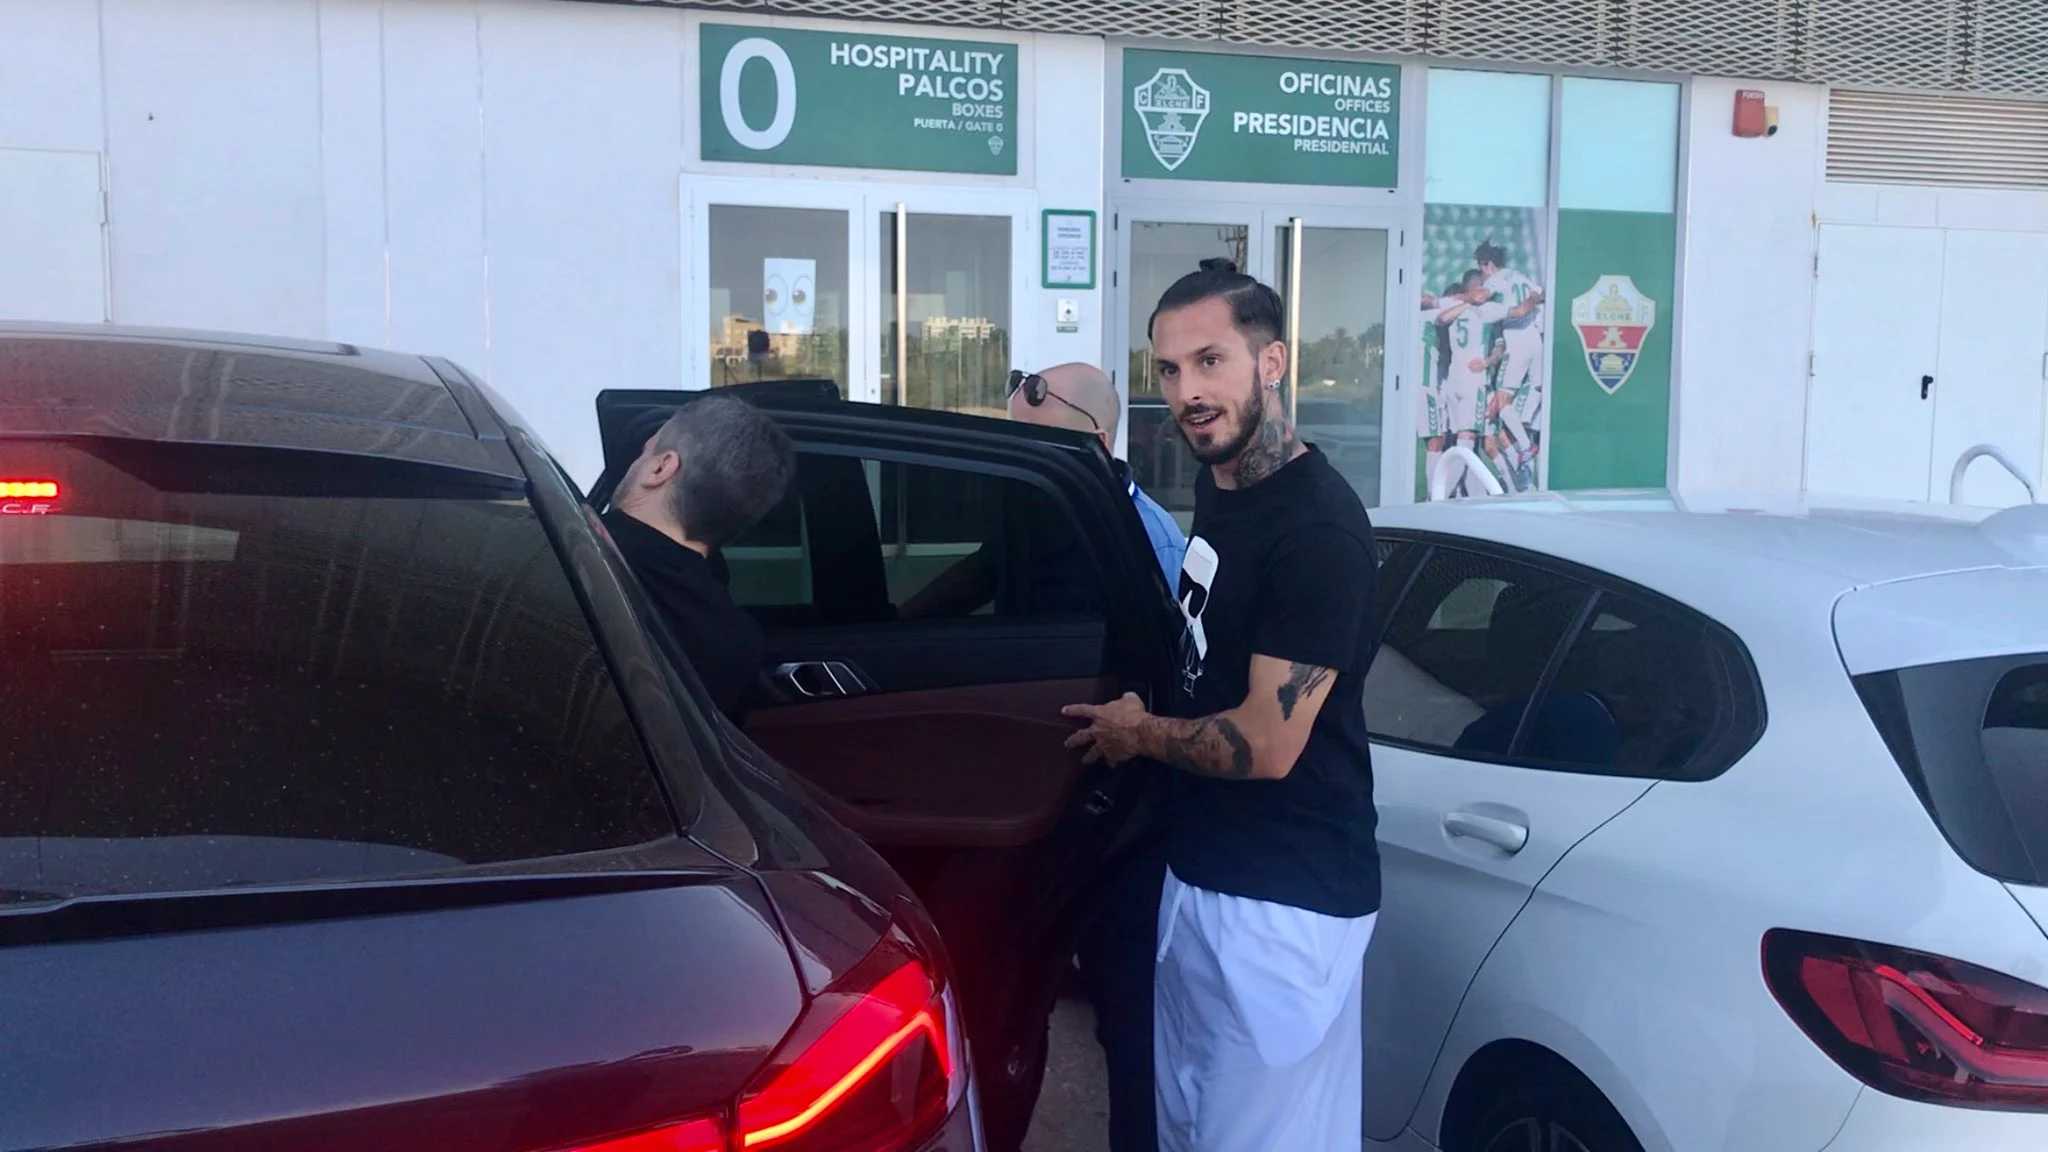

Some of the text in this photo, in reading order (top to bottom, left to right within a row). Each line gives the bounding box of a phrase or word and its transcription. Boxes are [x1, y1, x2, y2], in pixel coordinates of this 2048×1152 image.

[830, 42, 1004, 75] HOSPITALITY
[720, 37, 797, 150] 0
[899, 73, 1004, 101] PALCOS
[1279, 71, 1392, 98] OFICINAS
[1139, 91, 1148, 105] C
[1196, 94, 1205, 108] F
[1334, 98, 1391, 113] OFFICES
[952, 102, 1003, 118] BOXES
[914, 118, 956, 130] PUERTA
[965, 121, 994, 132] GATE
[1233, 112, 1389, 140] PRESIDENCIA
[1294, 139, 1389, 155] PRESIDENTIAL
[1456, 318, 1469, 348] 5
